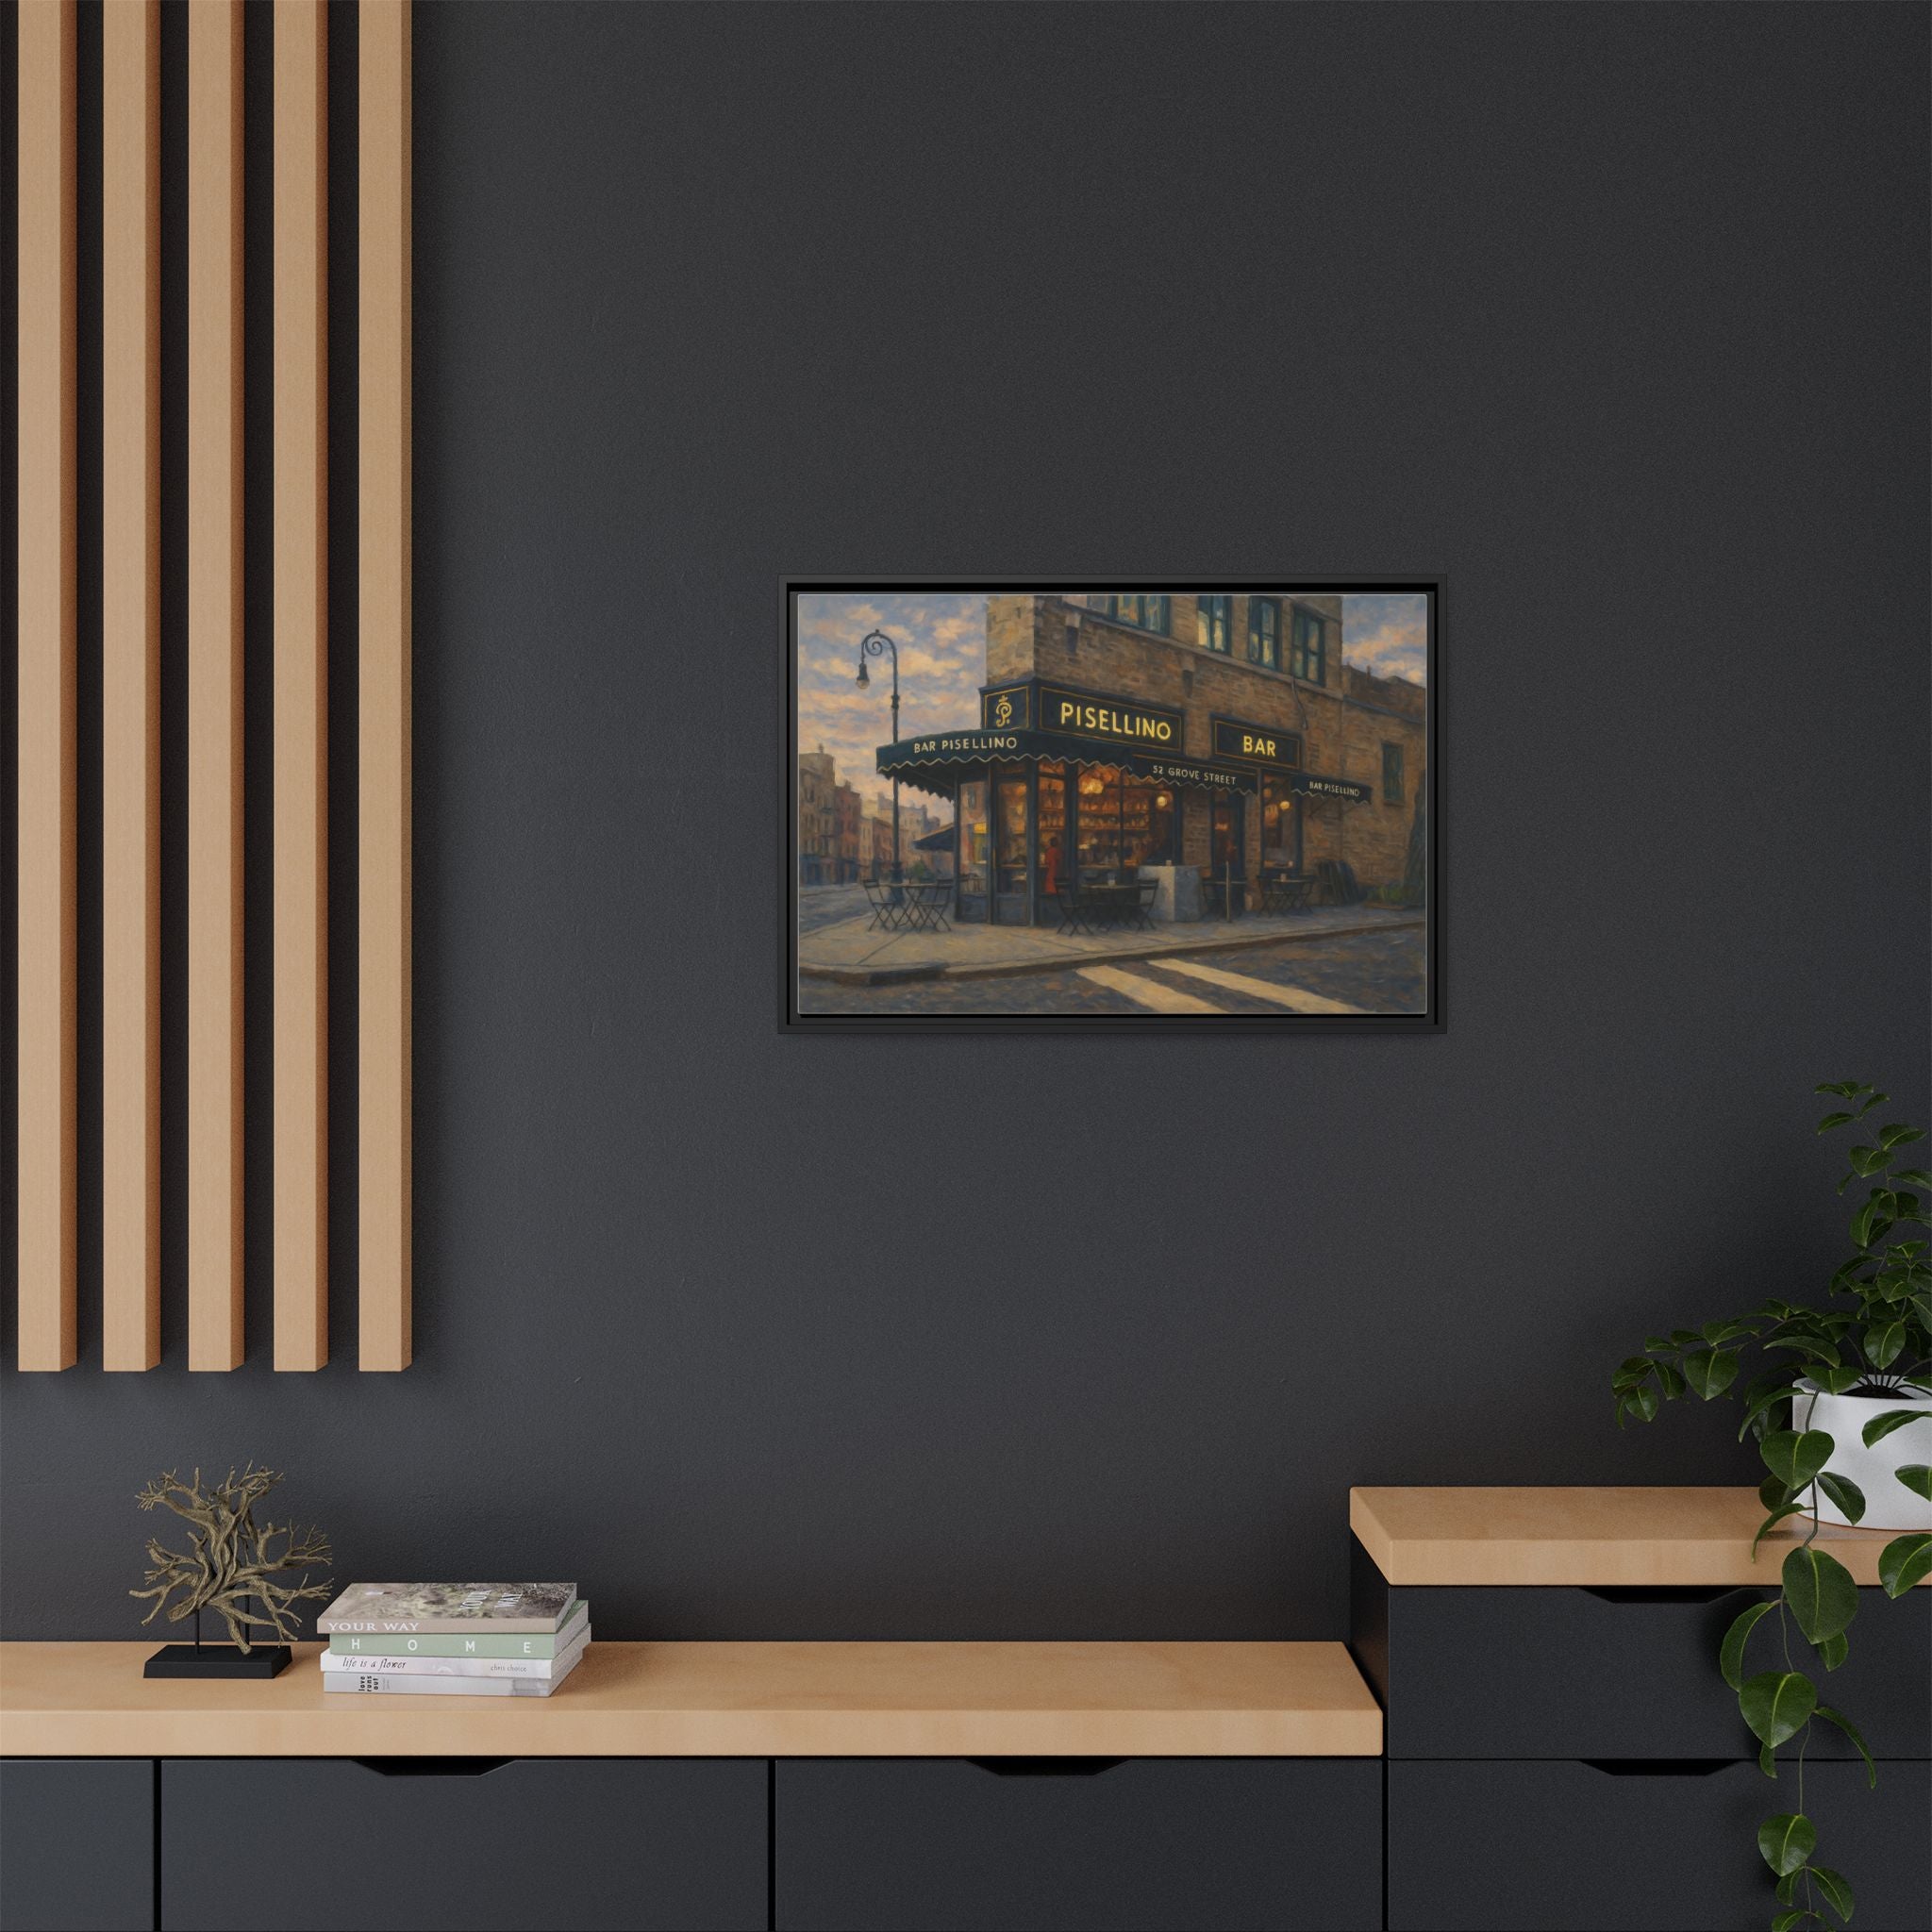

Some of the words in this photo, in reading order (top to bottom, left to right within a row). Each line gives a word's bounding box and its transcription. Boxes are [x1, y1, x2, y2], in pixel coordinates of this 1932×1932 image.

[1060, 702, 1172, 741] PISELLINO
[914, 741, 936, 754] BAR
[941, 737, 1018, 750] PISELLINO
[1242, 735, 1276, 757] BAR
[1153, 765, 1163, 774] 52
[1168, 767, 1200, 780] GROVE
[1204, 772, 1237, 785] STREET
[1309, 781, 1323, 791] BAR
[1324, 783, 1360, 797] PISELLINO
[327, 1622, 377, 1631] YOUR
[383, 1622, 420, 1631] WAY
[351, 1639, 531, 1653] HOME
[342, 1657, 357, 1670] life
[360, 1658, 367, 1668] is
[378, 1657, 407, 1671] flower
[491, 1663, 505, 1672] chris
[507, 1663, 526, 1672] choice
